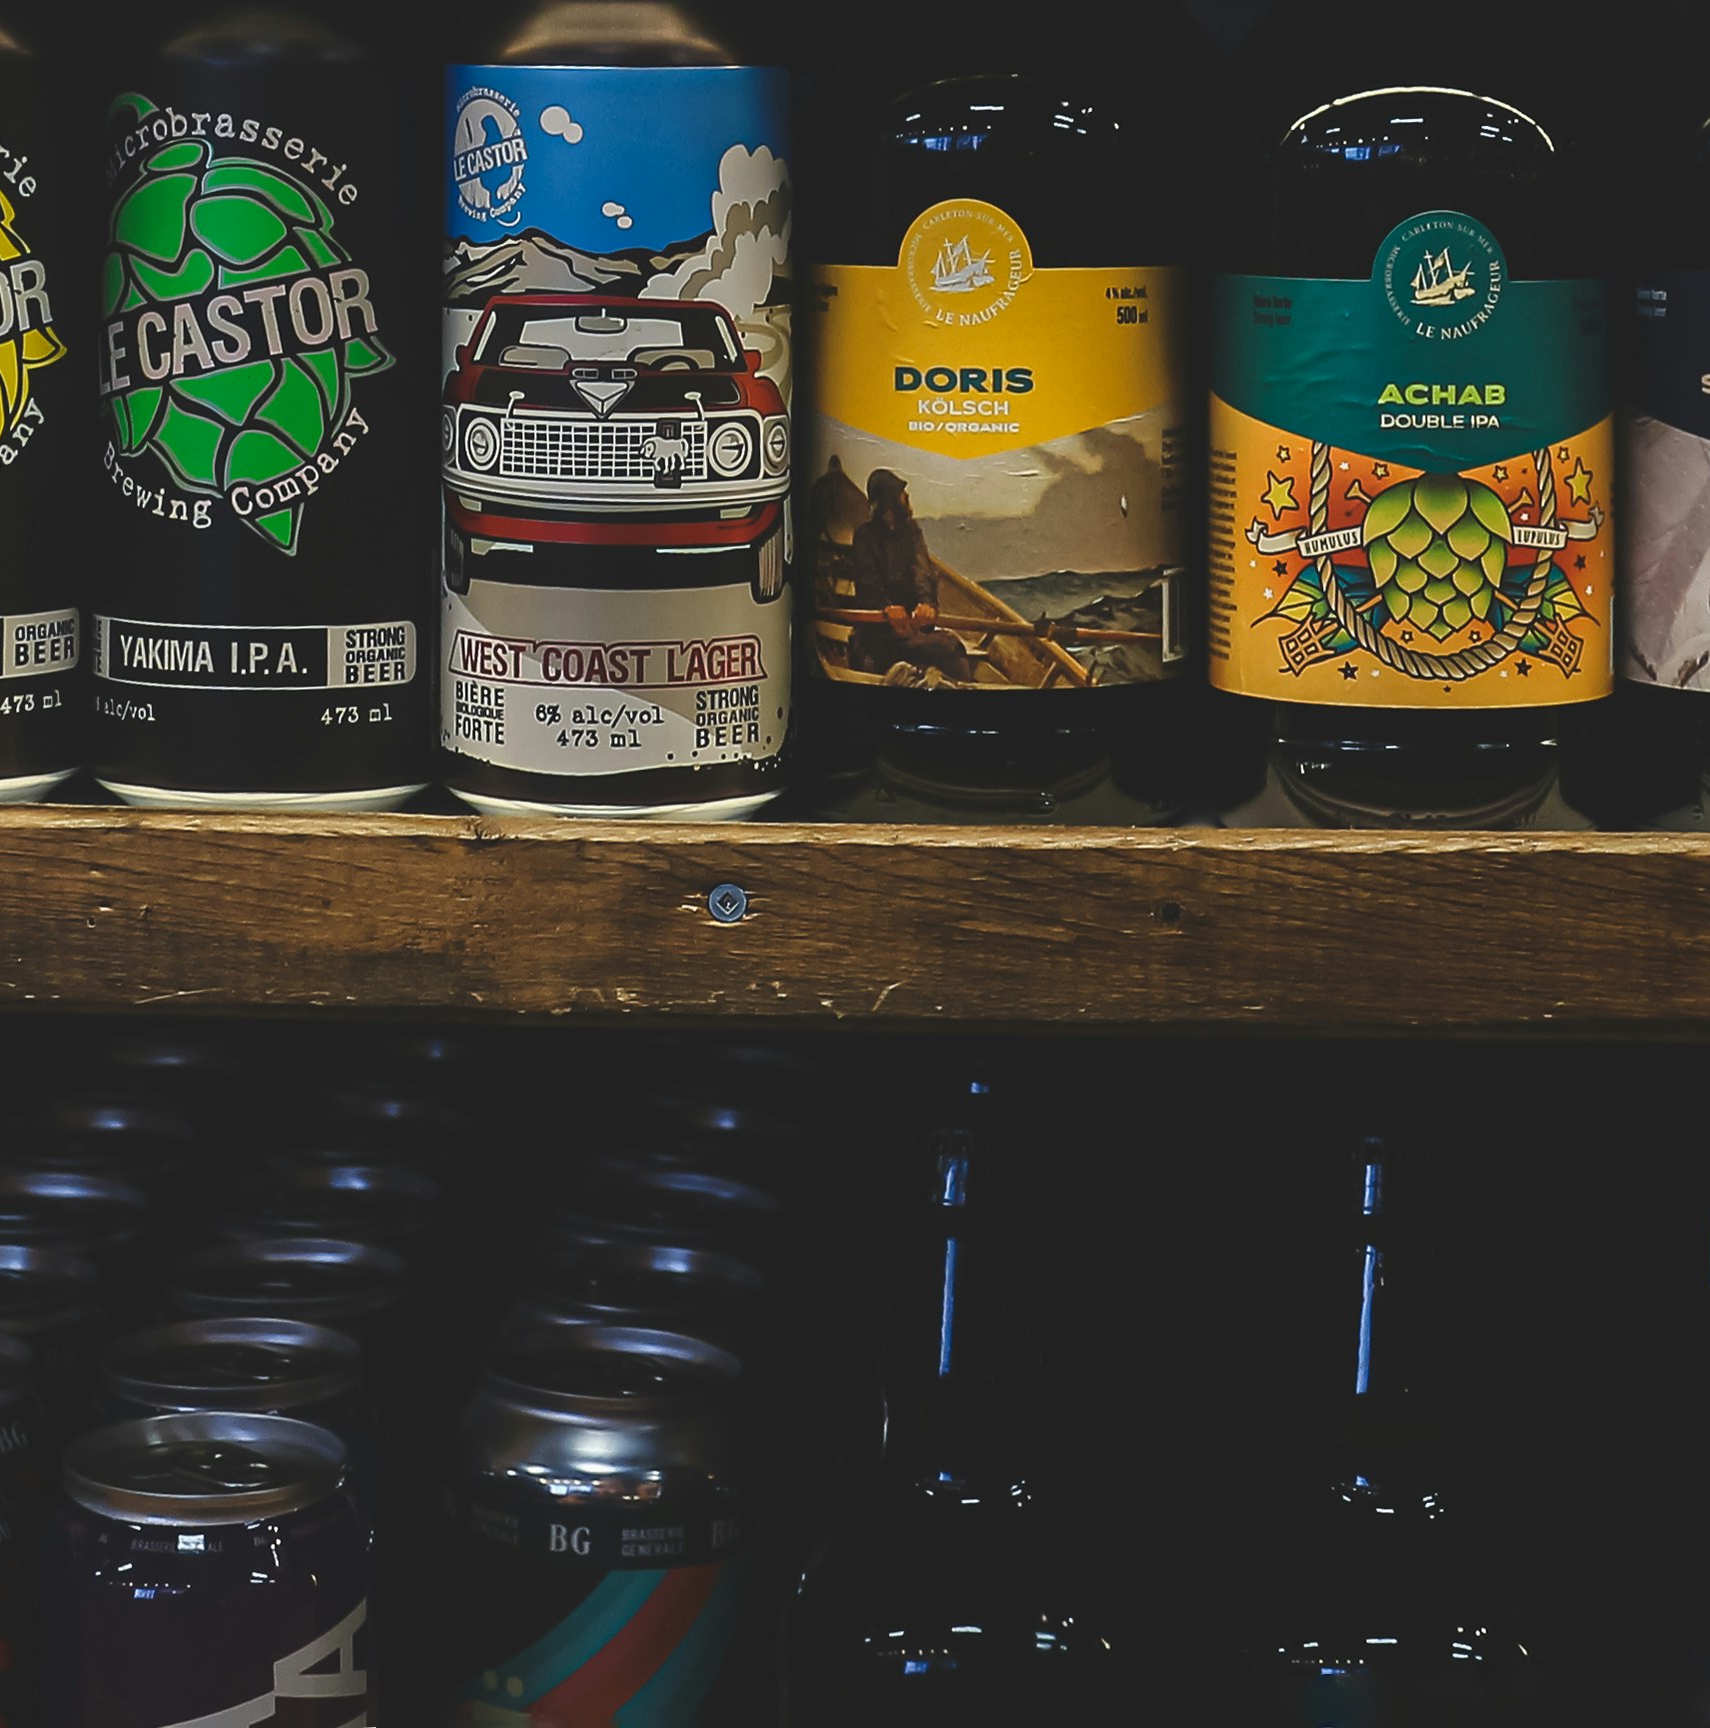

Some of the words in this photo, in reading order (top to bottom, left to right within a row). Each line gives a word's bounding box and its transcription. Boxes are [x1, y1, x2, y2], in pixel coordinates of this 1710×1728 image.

[452, 156, 467, 181] LE
[466, 136, 528, 175] CASTOR
[959, 248, 1023, 327] NAUFRAGEUR
[1440, 259, 1503, 341] NAUFRAGEUR
[136, 266, 380, 381] CASTOR
[894, 365, 1036, 394] DORIS
[917, 396, 1011, 417] KÖLSCH
[1377, 382, 1507, 407] ACHAB
[1379, 413, 1466, 430] DOUBLE
[1470, 413, 1501, 430] IPA
[1303, 532, 1361, 555] HUMULUS
[345, 625, 407, 649] STRONG
[119, 634, 216, 674] YAKIMA
[345, 647, 407, 664] ORGANIC
[459, 635, 528, 679] WEST
[541, 645, 652, 685] COAST
[666, 641, 761, 684] LAGER
[344, 660, 407, 685] BEER
[0, 693, 36, 715] 473
[455, 679, 505, 708] BIÈRE
[695, 684, 760, 712] STRONG
[454, 713, 505, 746] FORTE
[571, 704, 666, 729] alc/vol
[556, 728, 600, 749] 473
[695, 722, 760, 750] BEER
[548, 1523, 591, 1556] BG
